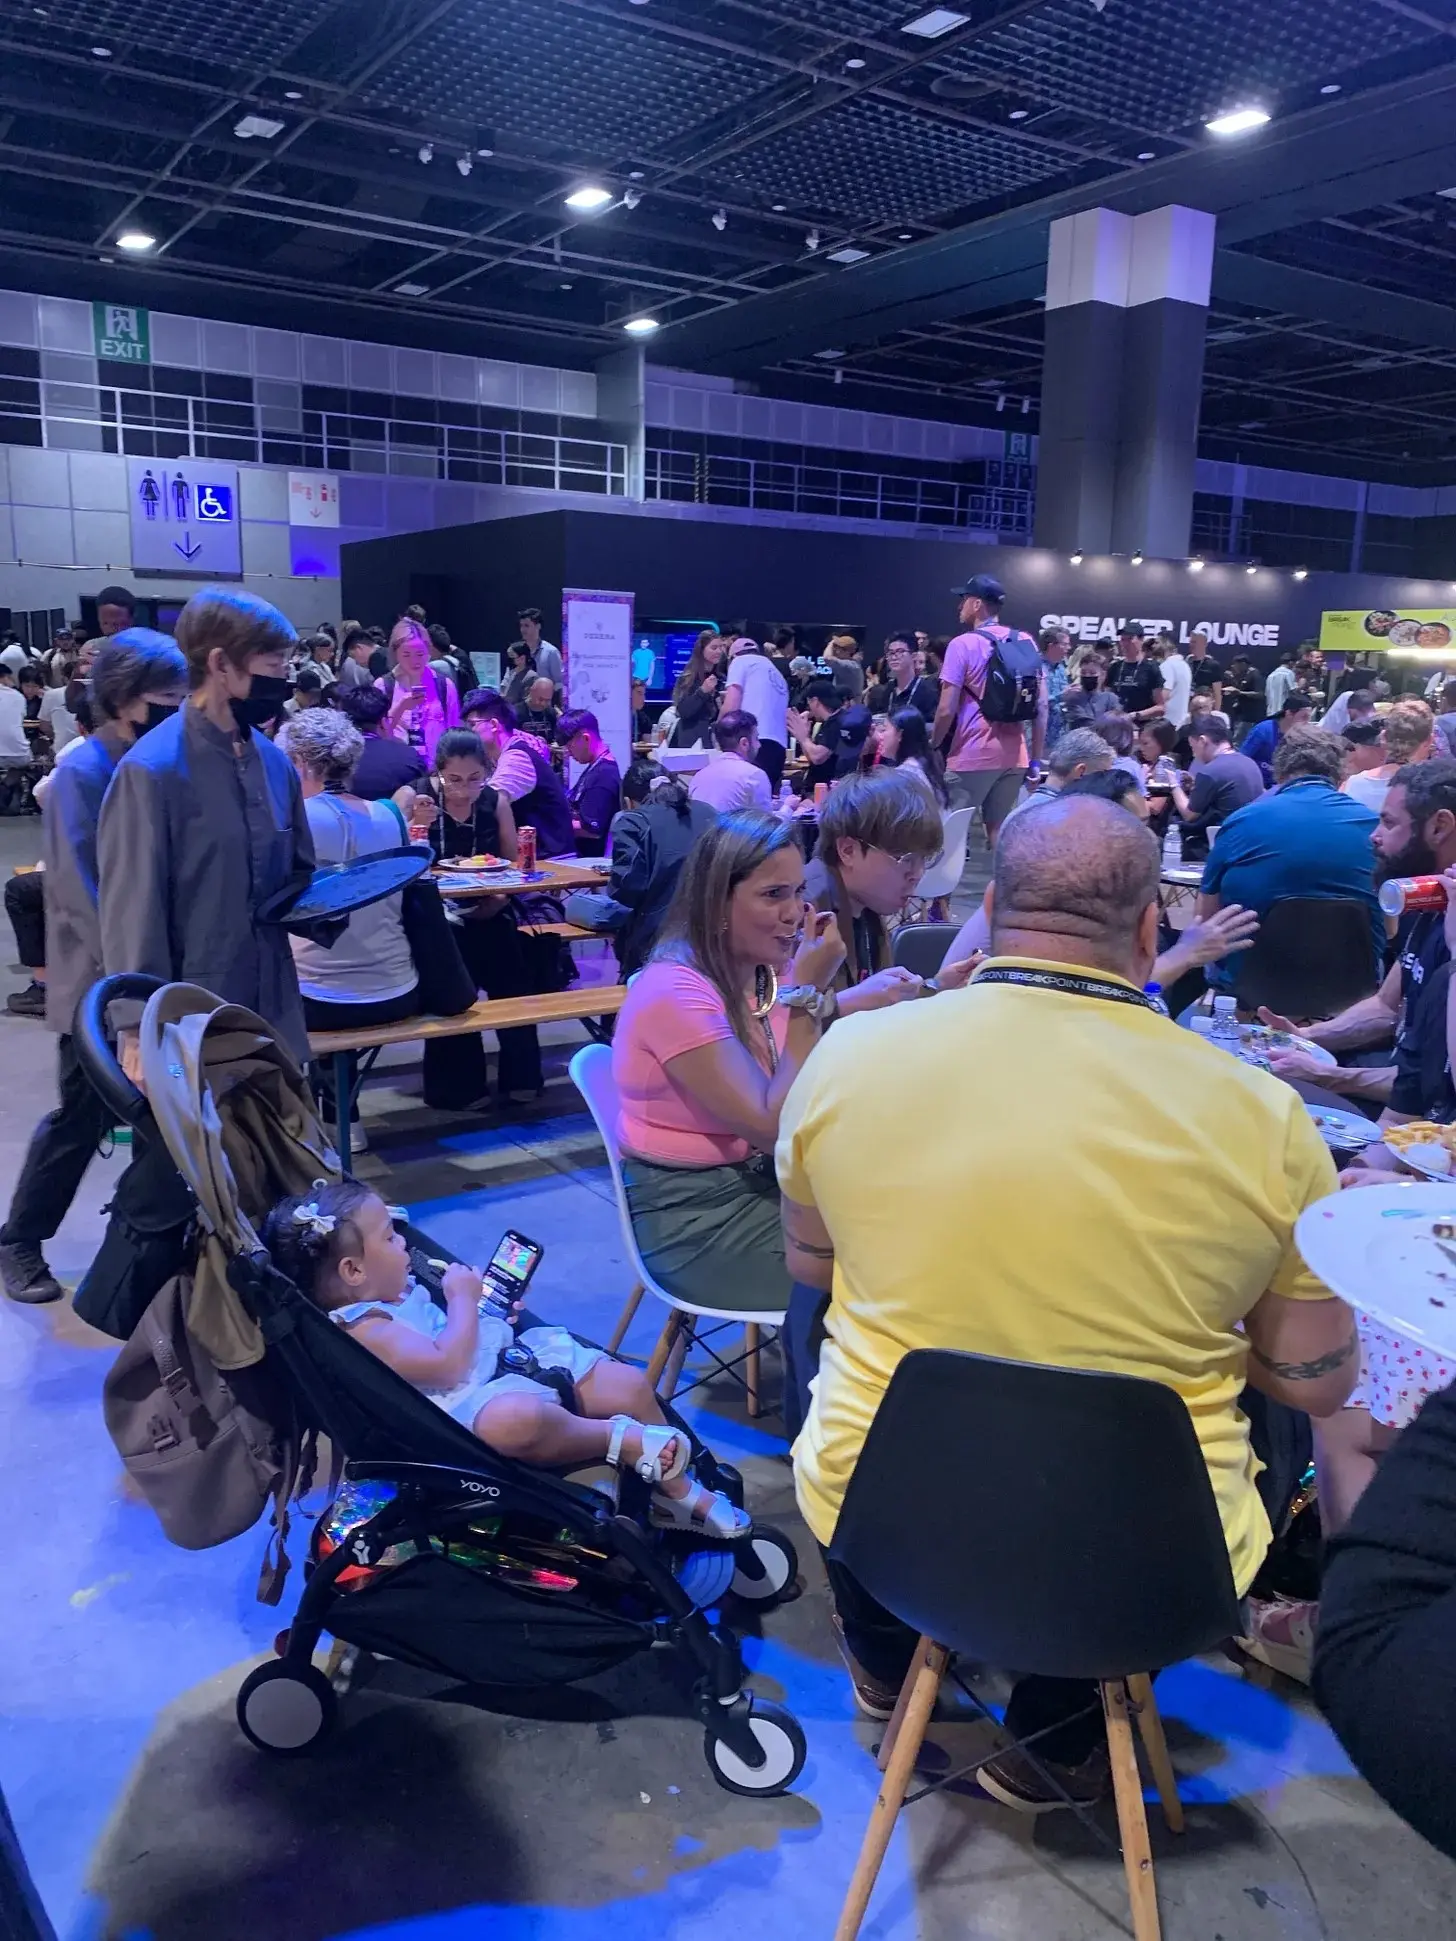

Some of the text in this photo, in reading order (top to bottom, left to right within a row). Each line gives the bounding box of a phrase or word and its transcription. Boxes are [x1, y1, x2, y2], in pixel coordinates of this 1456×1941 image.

[101, 340, 145, 358] EXIT
[1179, 620, 1280, 647] LOUNGE
[460, 1480, 500, 1497] YOYO
